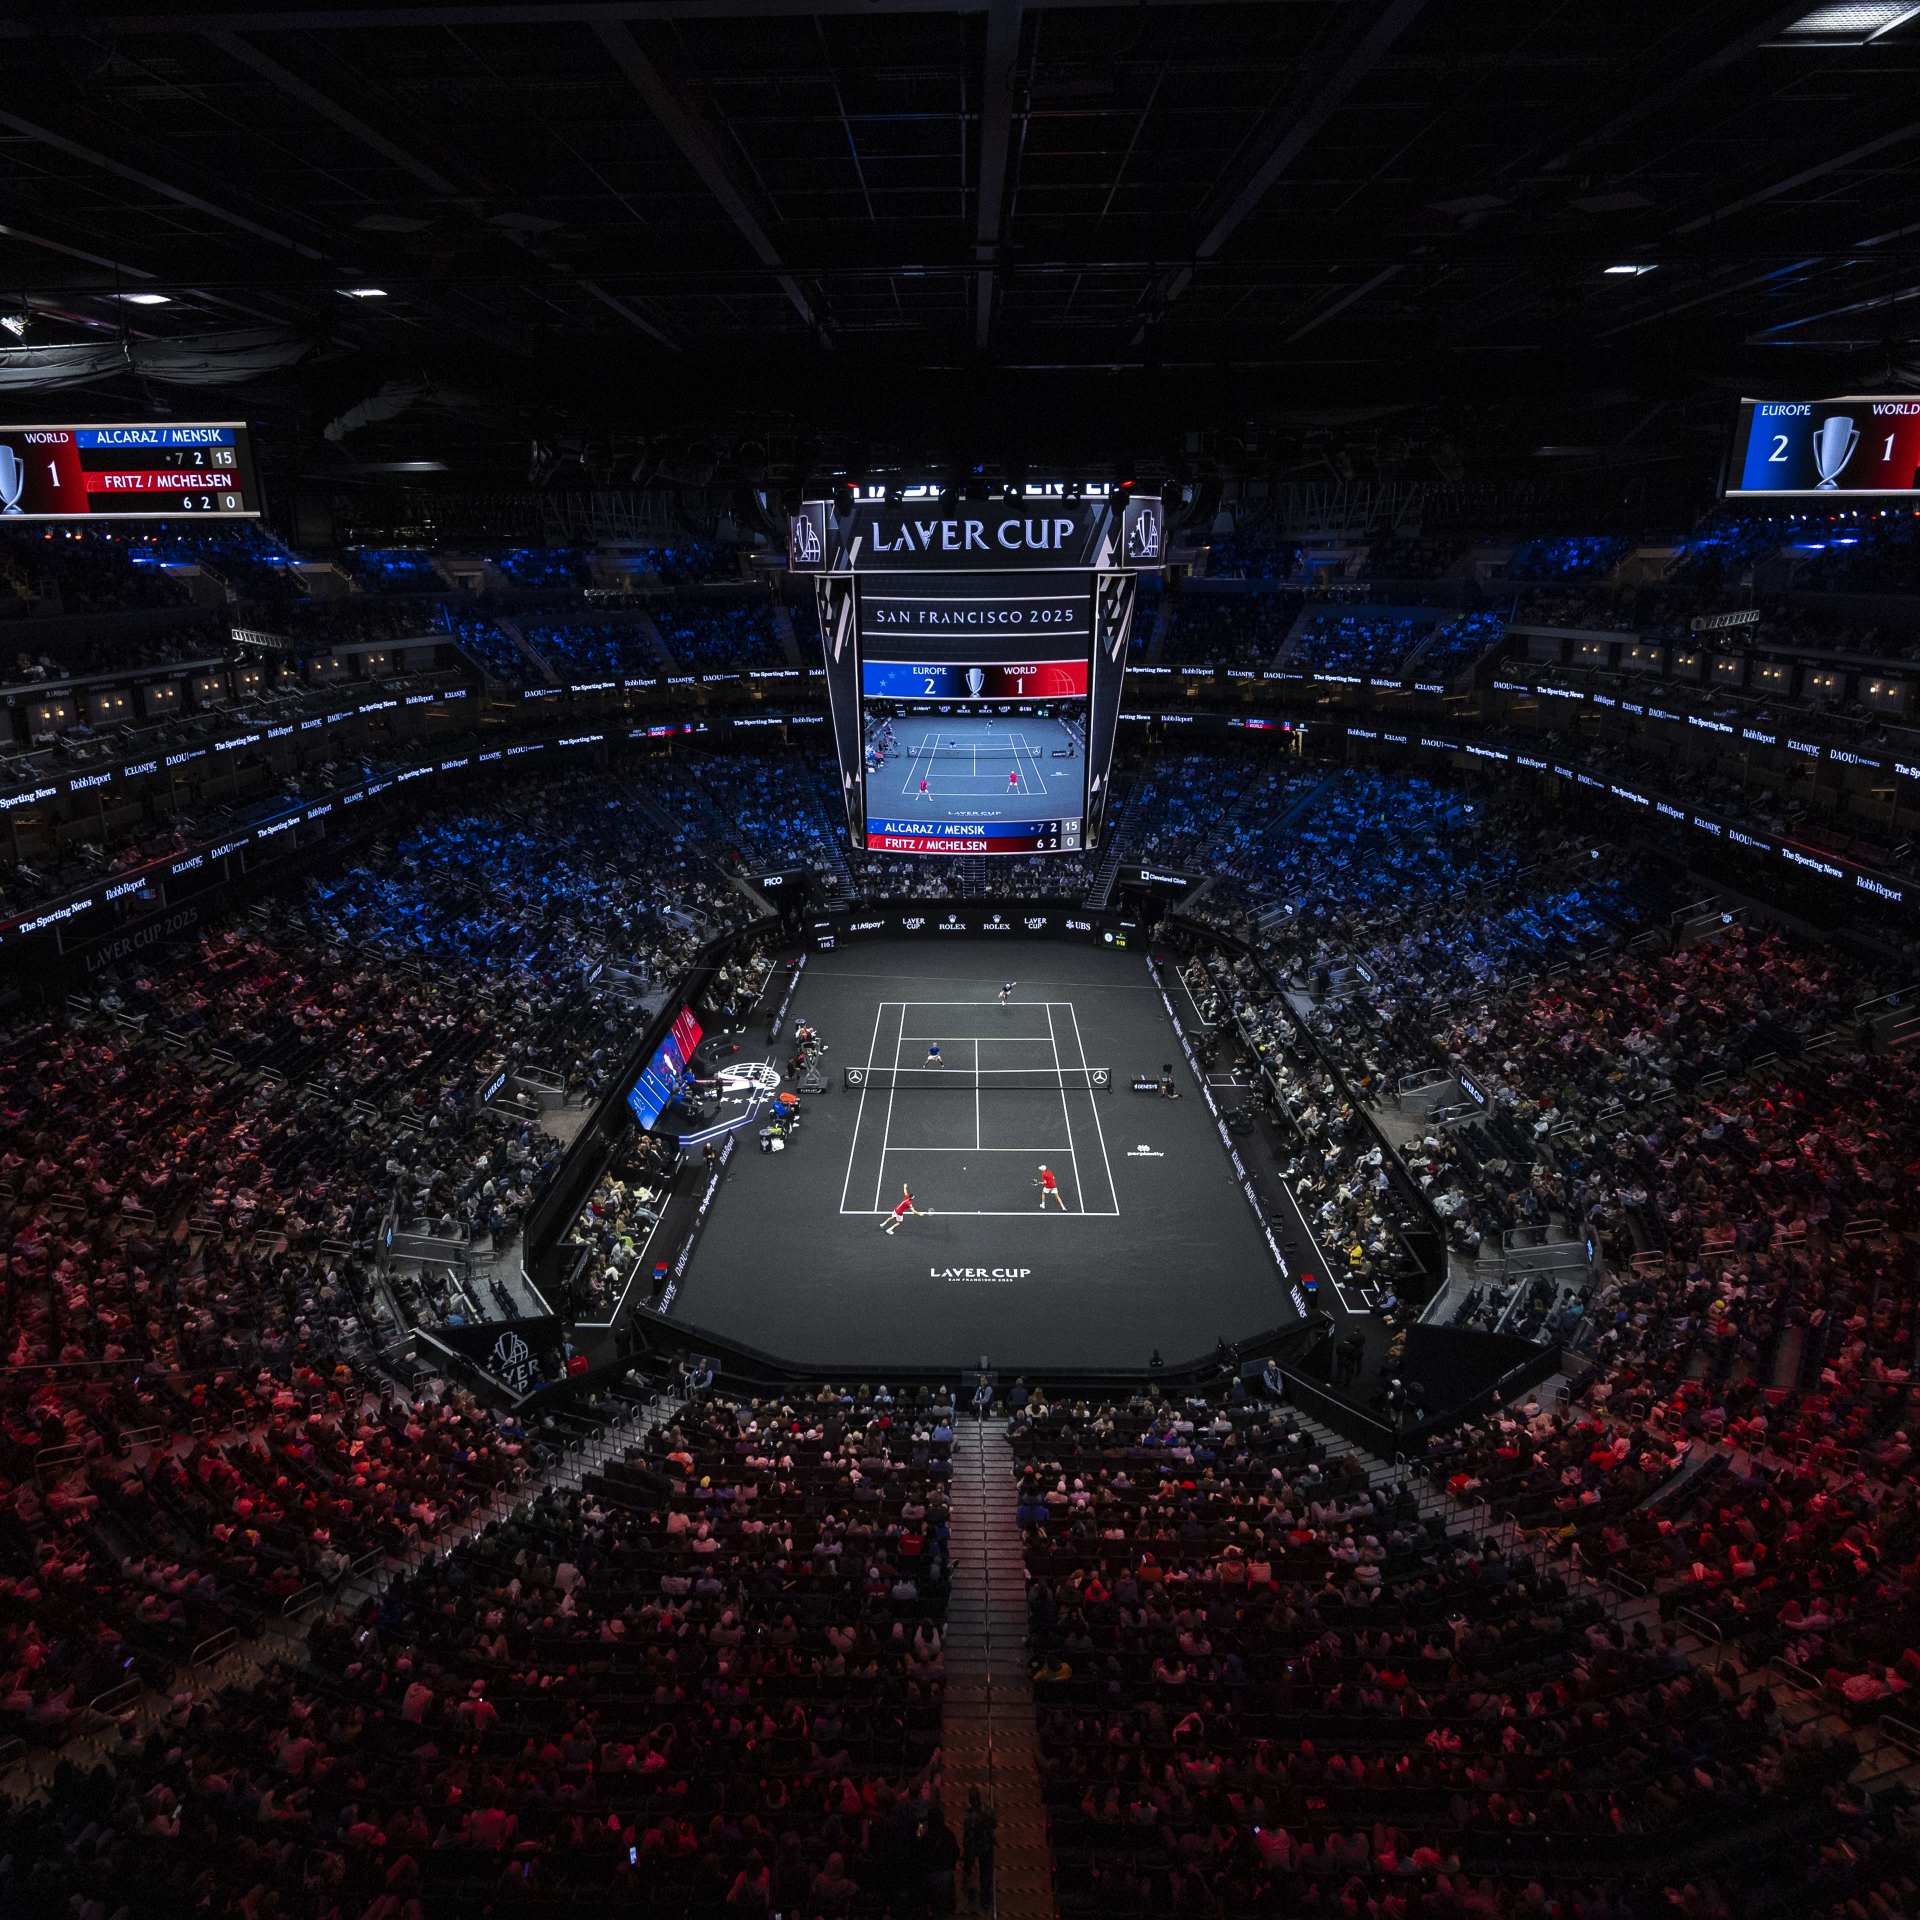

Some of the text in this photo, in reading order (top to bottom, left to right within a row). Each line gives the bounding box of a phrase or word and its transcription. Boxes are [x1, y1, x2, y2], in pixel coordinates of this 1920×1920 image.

[1761, 404, 1810, 416] EUROPE
[1873, 404, 1920, 415] WORLD
[25, 433, 69, 443] WORLD
[97, 430, 158, 444] ALCARAZ
[172, 429, 222, 442] MENSIK
[1768, 434, 1788, 462] 2
[1883, 433, 1894, 461] 1
[175, 452, 231, 464] 7 2 15
[48, 461, 60, 486] 1
[104, 475, 144, 489] FRITZ
[157, 474, 231, 488] MICHELSEN
[184, 496, 235, 509] 6 2 0
[872, 519, 1074, 551] LAVER CUP
[877, 610, 1073, 623] SAN FRANCISCO 2025
[912, 666, 947, 675] EUROPE
[1004, 666, 1037, 675] WORLD
[924, 678, 936, 695] 2
[1017, 678, 1023, 694] 1
[1421, 739, 1443, 747] DAOU
[166, 753, 186, 766] DAOU
[1830, 749, 1856, 764] DAOU
[1895, 764, 1909, 774] The
[71, 773, 111, 790] Robb Report
[0, 788, 56, 808] Sporting News
[884, 822, 934, 834] ALCARAZ
[944, 825, 985, 835] MENSIK
[1038, 822, 1077, 832] 7 2 15
[1037, 837, 1074, 848] 6 2 0
[1730, 830, 1750, 844] DAOU
[212, 843, 233, 858] DAOU
[885, 838, 916, 849] FRITZ
[926, 840, 987, 851] MICHELSEN
[1782, 848, 1842, 878] The Sporting News
[764, 877, 782, 886] FICO
[106, 878, 147, 900] Robb Report
[1857, 876, 1902, 901] Robb Report
[19, 900, 92, 933] The Sporting News
[134, 923, 165, 948] CUP
[164, 907, 200, 935] 2025
[1075, 922, 1090, 930] UBS
[931, 1268, 1031, 1277] LAVER CUP
